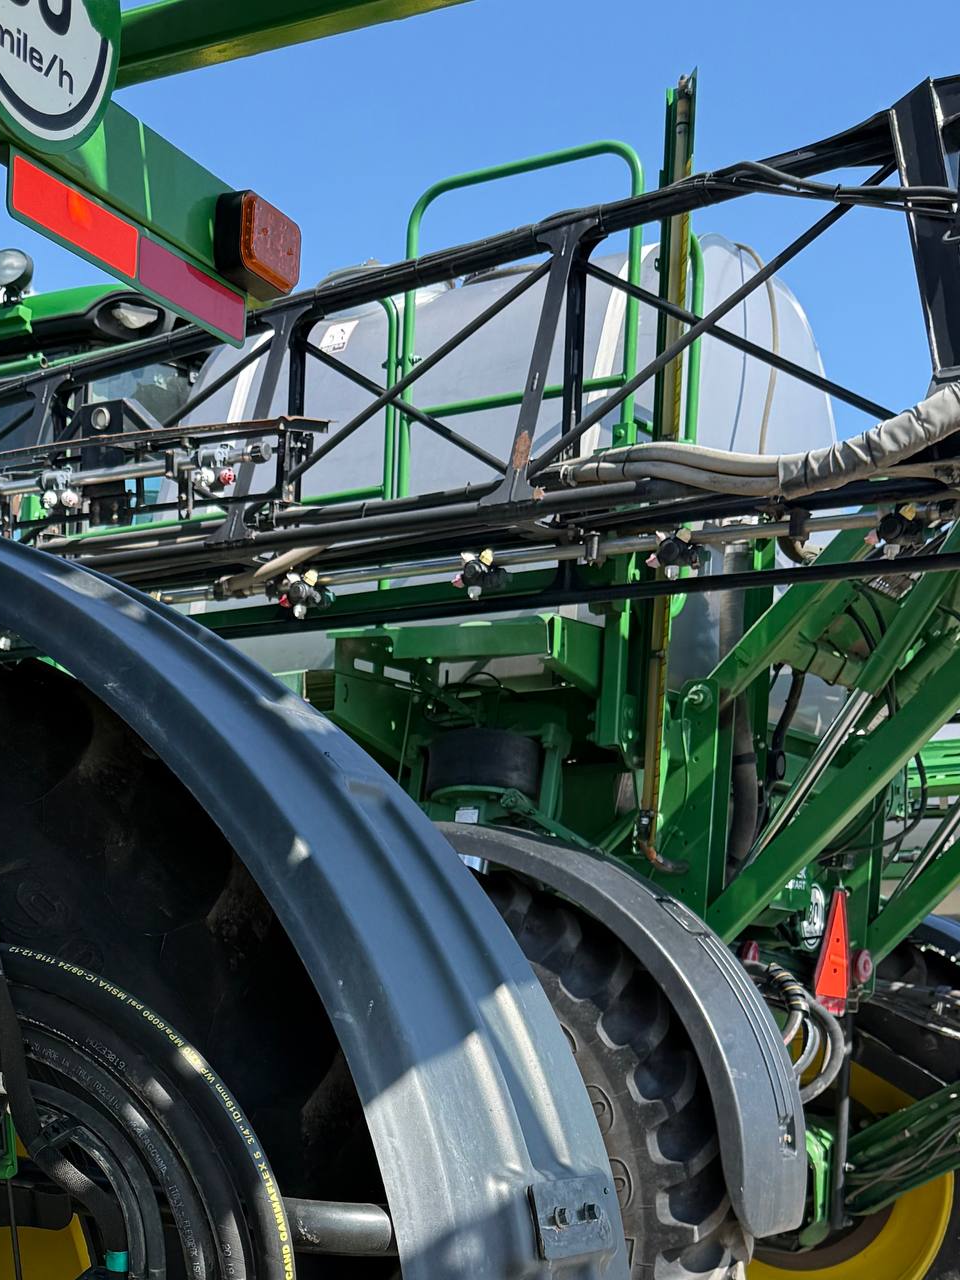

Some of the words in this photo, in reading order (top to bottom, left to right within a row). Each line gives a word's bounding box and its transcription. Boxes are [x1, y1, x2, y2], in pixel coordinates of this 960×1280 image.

[98, 978, 128, 1001] MSHA
[126, 995, 145, 1012] psi
[141, 1007, 185, 1049] MPa/6090
[200, 1065, 216, 1083] WP
[238, 1123, 255, 1145] 3/4"
[257, 1161, 288, 1242] GAMMAFLEX
